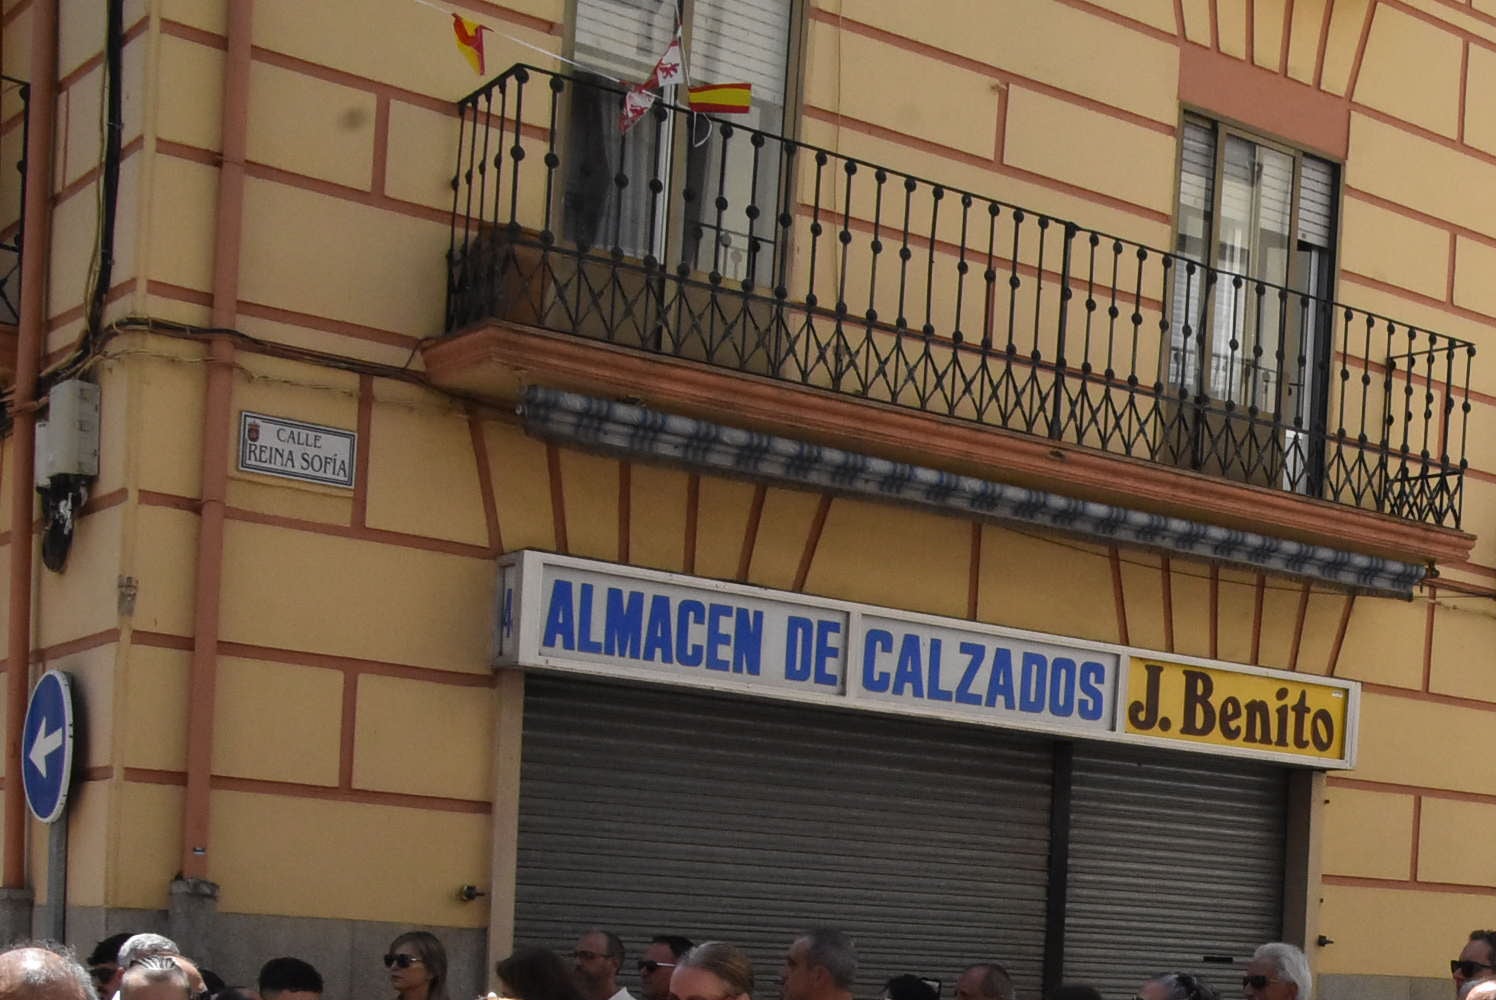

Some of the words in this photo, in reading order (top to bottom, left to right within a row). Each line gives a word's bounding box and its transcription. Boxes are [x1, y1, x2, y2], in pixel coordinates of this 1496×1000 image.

[276, 428, 322, 449] CALLE
[248, 443, 295, 468] REINA
[300, 453, 348, 478] SOFÍA
[542, 579, 764, 676] ALMACEN
[784, 615, 841, 686] DE
[862, 629, 1105, 721] CALZADOS
